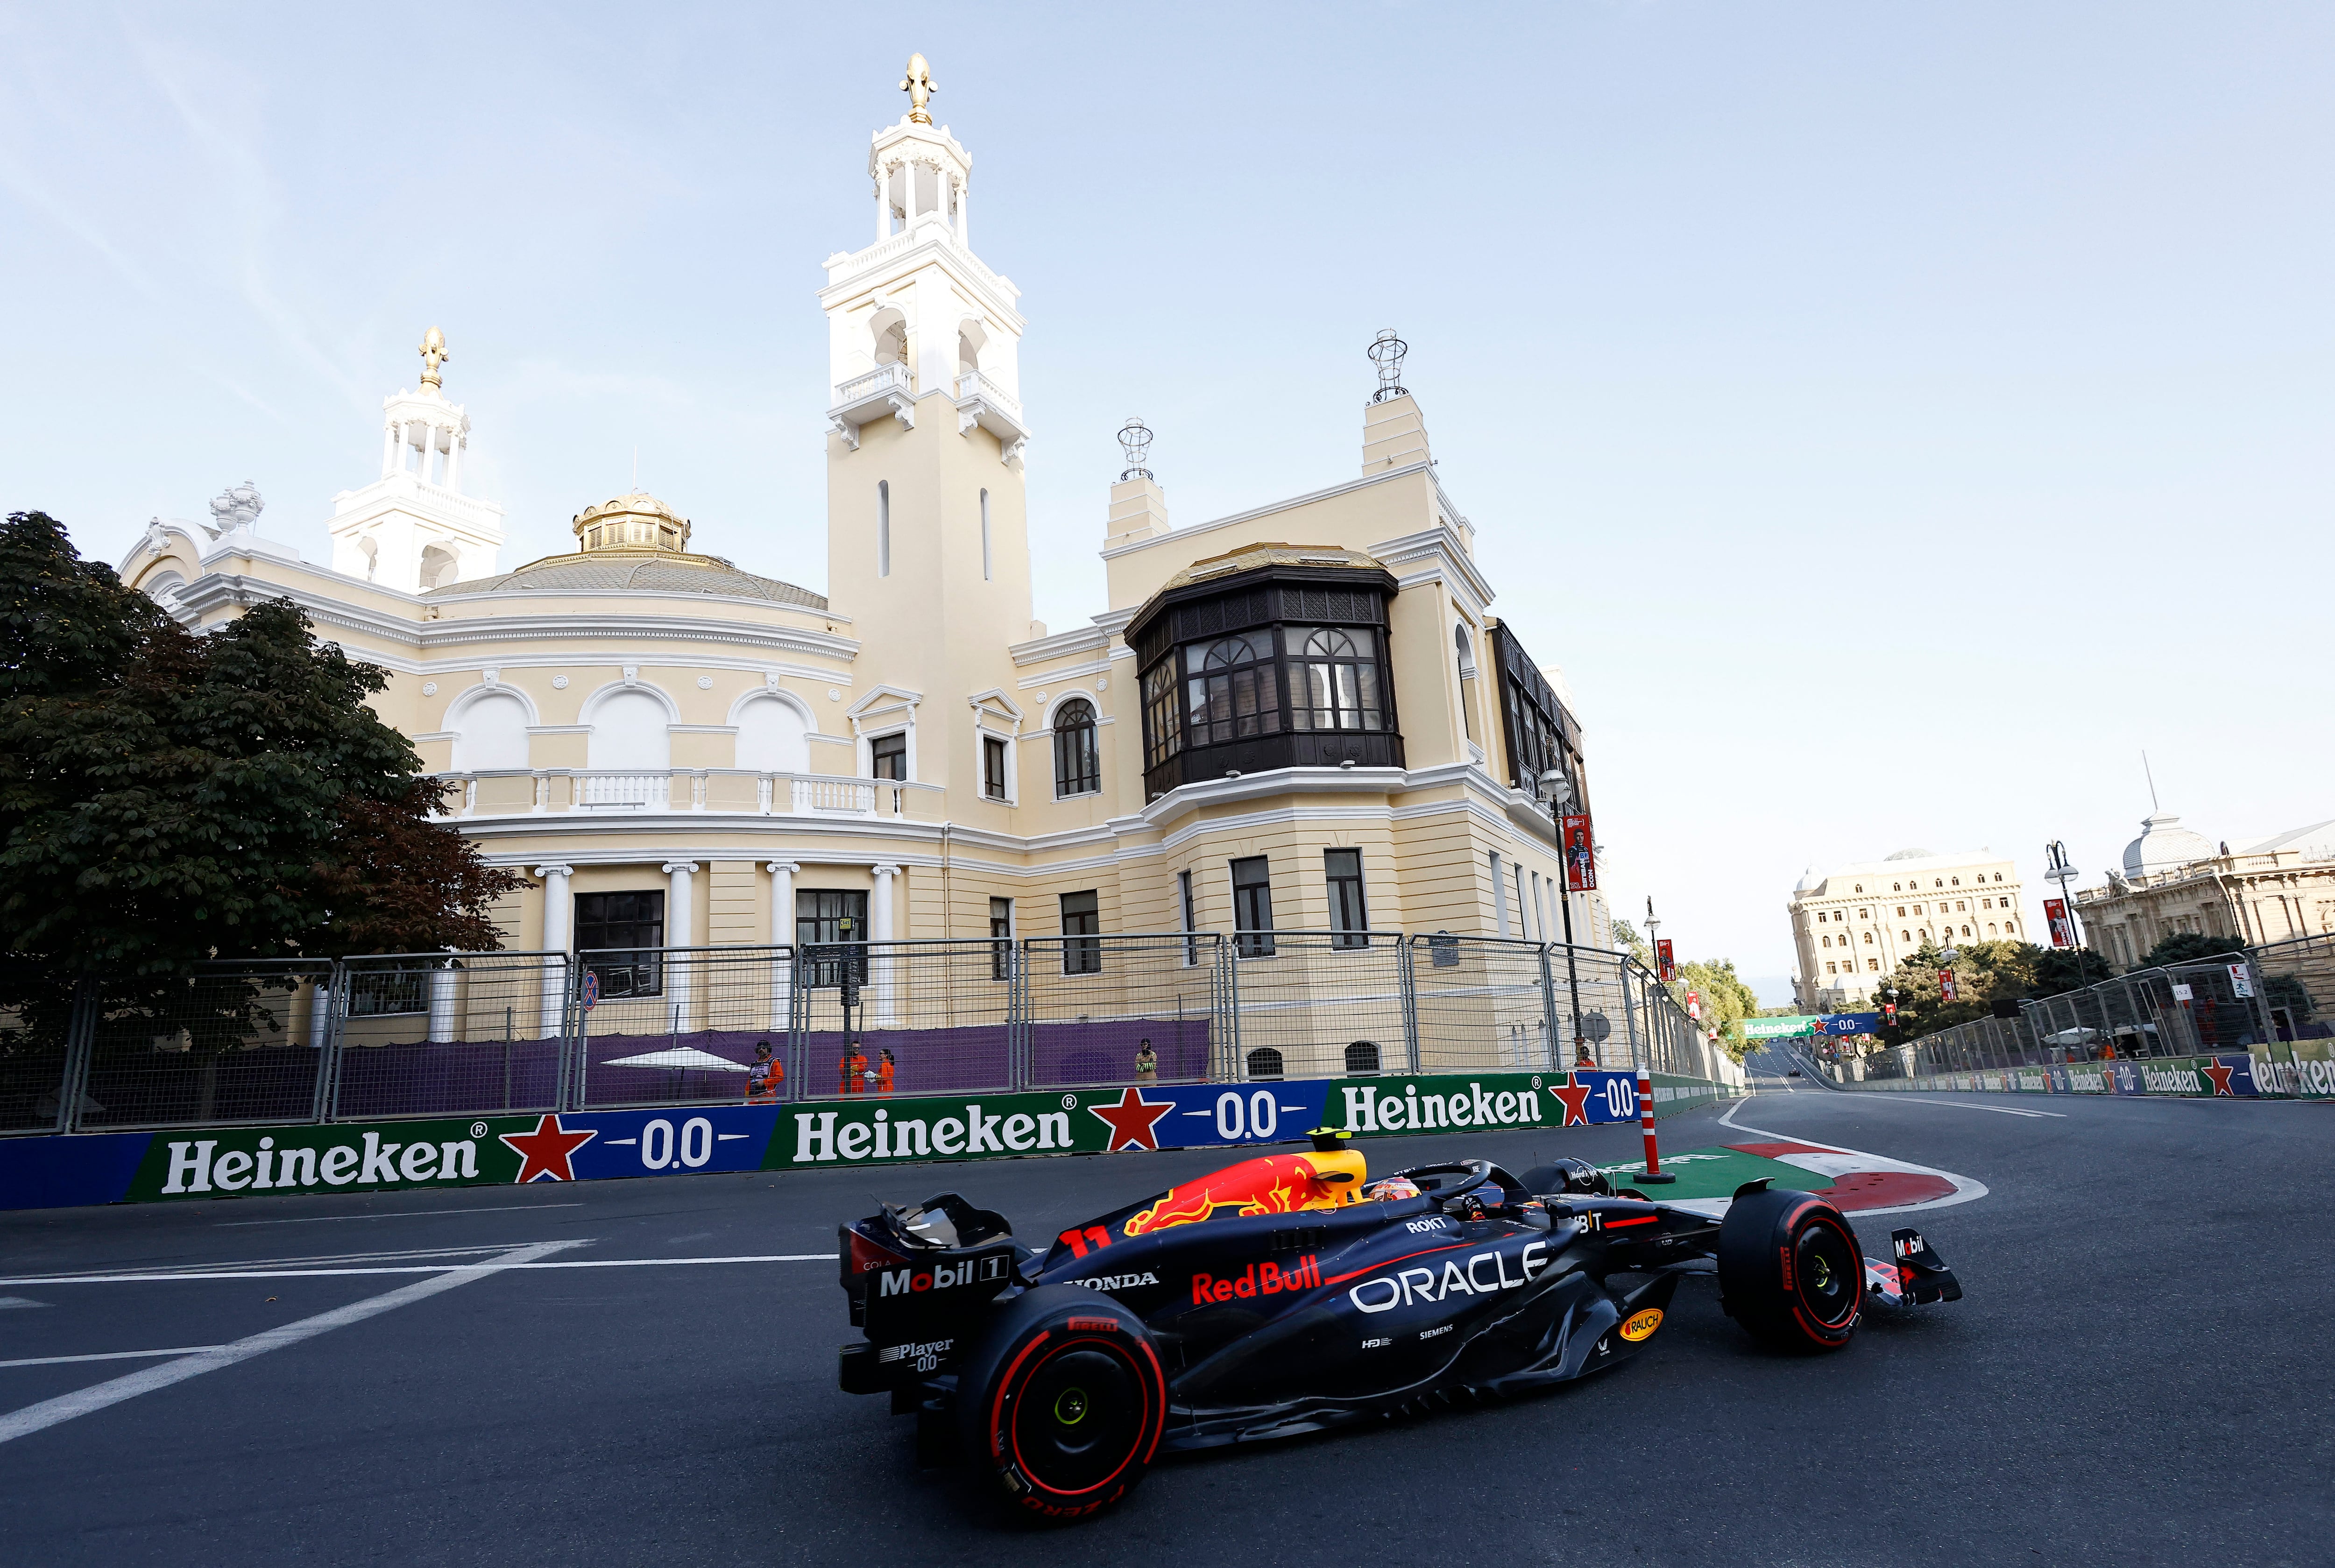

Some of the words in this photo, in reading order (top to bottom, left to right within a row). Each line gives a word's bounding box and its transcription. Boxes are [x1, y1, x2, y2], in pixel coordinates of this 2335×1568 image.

[1744, 1022, 1806, 1035] Heineken
[1838, 1018, 1855, 1031] 0.0
[2141, 1064, 2202, 1092] Heineken
[1341, 1082, 1543, 1132] Heineken
[1606, 1078, 1634, 1118] 0.0
[1217, 1090, 1277, 1139] 0.0
[642, 1117, 713, 1170] 0.0
[793, 1105, 1074, 1162] Heineken
[162, 1131, 479, 1194] Heineken
[1394, 1166, 1416, 1176] BYBIT
[1571, 1170, 1585, 1179] Hard
[1405, 1217, 1447, 1234] ROKT
[1058, 1225, 1112, 1259] 11
[1895, 1235, 1924, 1257] Mobil
[880, 1260, 974, 1297] Mobil
[989, 1258, 998, 1278] 1
[1063, 1272, 1159, 1292] ONDA
[1192, 1272, 1257, 1305] Red
[1259, 1254, 1321, 1295] Bull
[1349, 1241, 1548, 1314] ORACLE
[1420, 1324, 1453, 1340] SIEMENS
[1631, 1314, 1659, 1333] RAUCH
[899, 1339, 954, 1359] Player
[917, 1355, 937, 1372] 0.0
